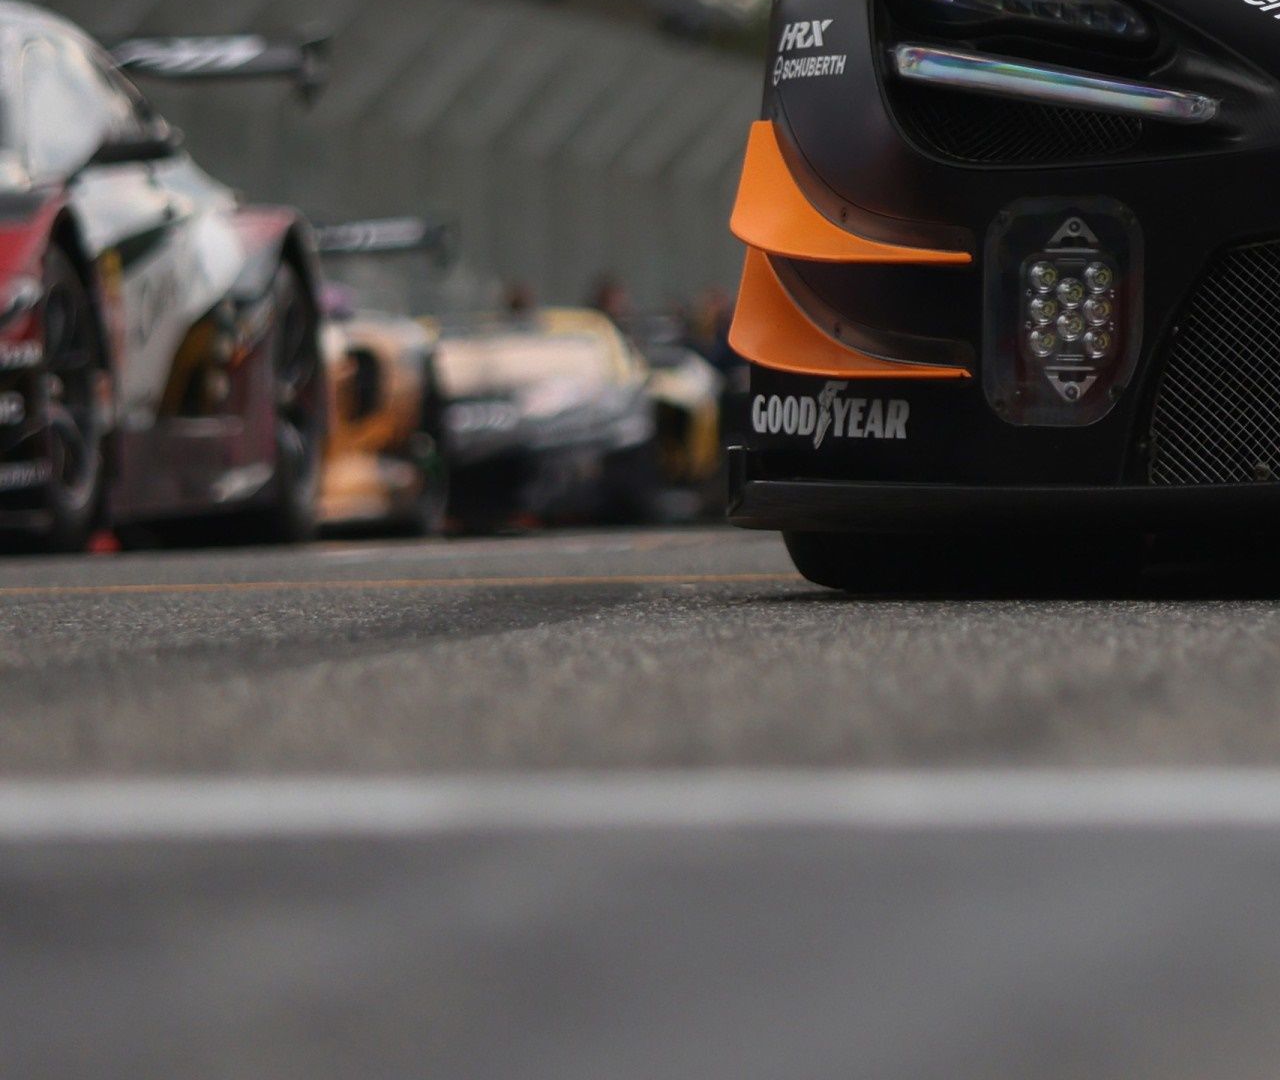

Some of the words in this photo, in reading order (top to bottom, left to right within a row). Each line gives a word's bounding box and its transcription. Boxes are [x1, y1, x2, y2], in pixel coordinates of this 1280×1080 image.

[778, 18, 834, 53] HRX
[781, 54, 847, 81] SCHUBERTH
[752, 392, 910, 441] GOODYEAR
